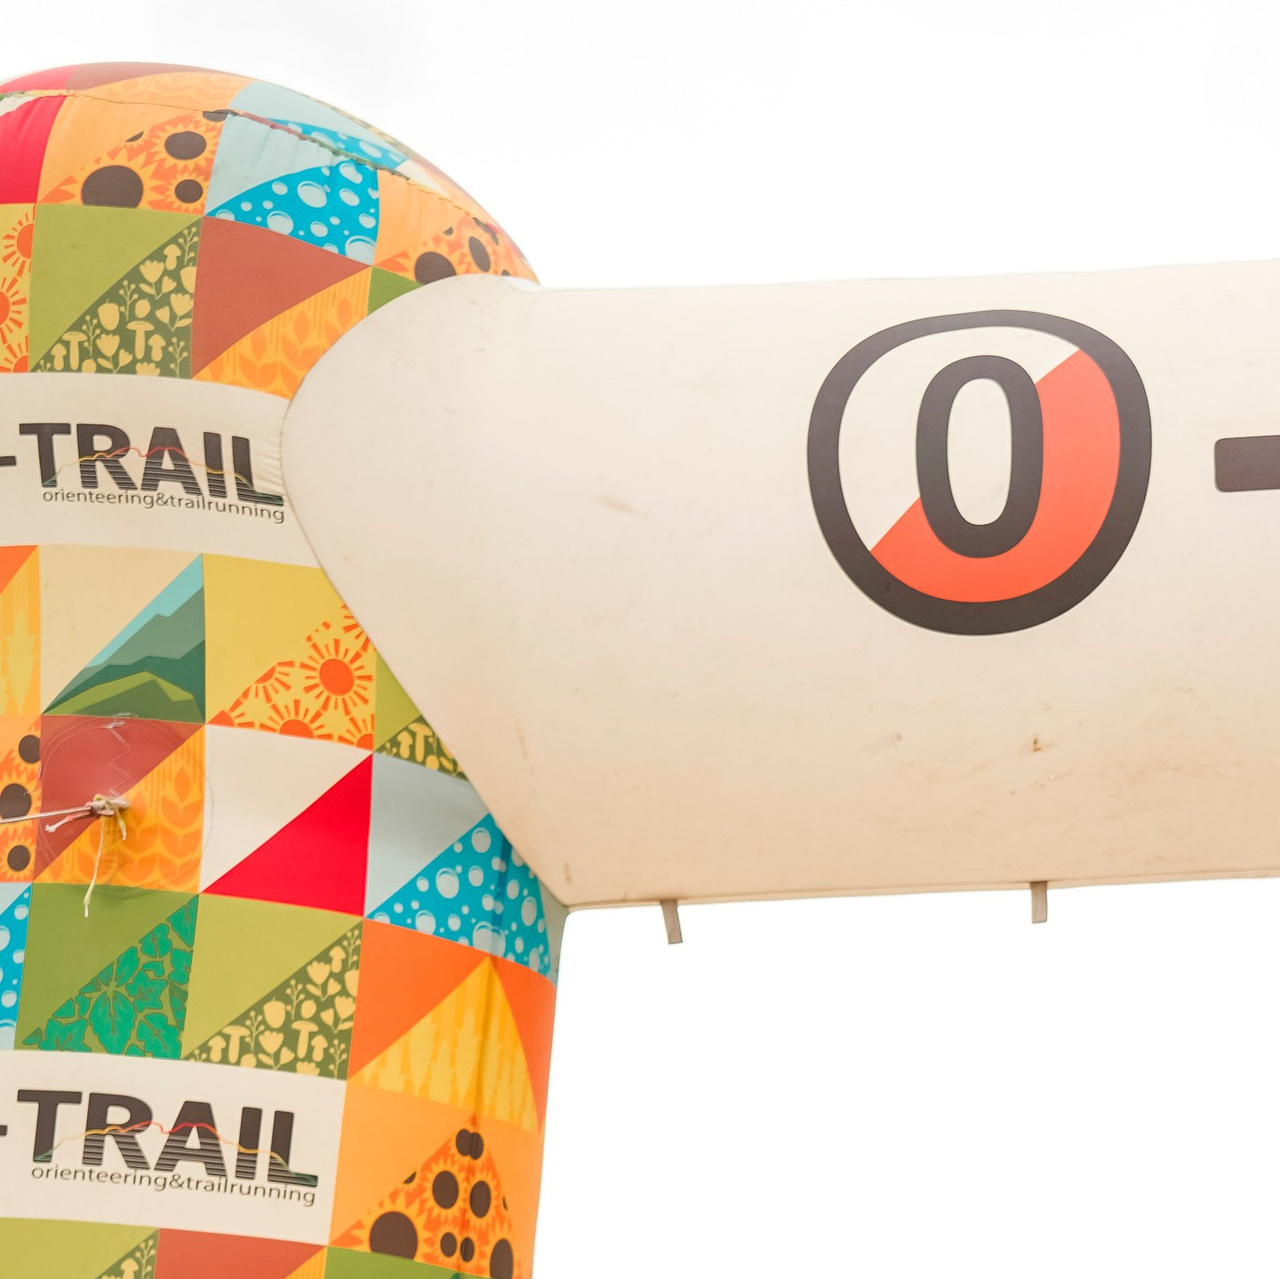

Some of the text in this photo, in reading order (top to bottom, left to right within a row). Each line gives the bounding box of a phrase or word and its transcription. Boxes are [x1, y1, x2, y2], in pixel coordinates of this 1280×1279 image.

[0, 422, 284, 507] -TRAIL
[42, 487, 285, 525] orienteering&trailrunning
[0, 1089, 318, 1187] TRAIL
[31, 1163, 317, 1207] orienteering&trailrunning
